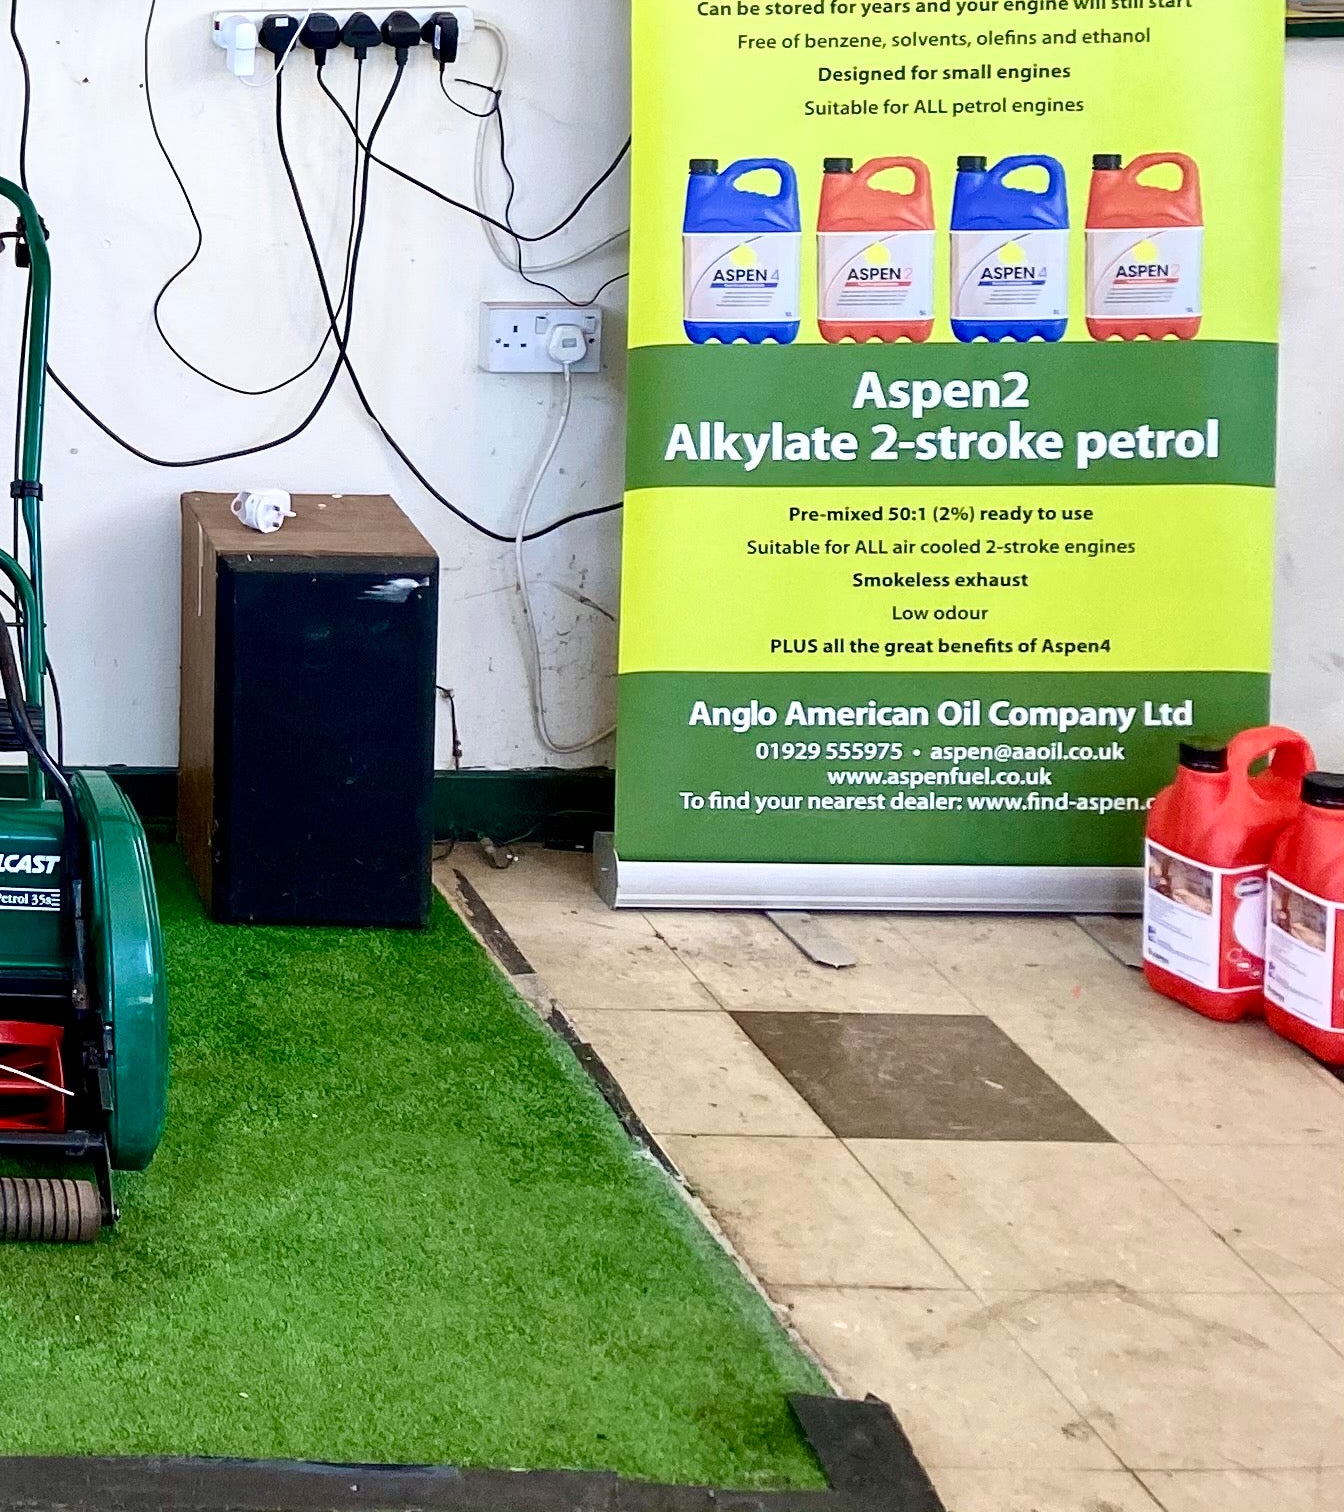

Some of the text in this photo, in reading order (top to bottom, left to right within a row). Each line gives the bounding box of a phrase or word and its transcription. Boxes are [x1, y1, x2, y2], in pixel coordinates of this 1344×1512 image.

[697, 1, 731, 16] Can
[737, 0, 760, 16] be
[765, 0, 825, 16] stored
[861, 2, 911, 18] years
[956, 0, 999, 17] your
[738, 27, 1150, 50] Free of benzene, solvents, olefins and ethanol
[818, 63, 1071, 86] Designed for small engines
[804, 97, 1084, 117] Suitable for ALL petrol engines
[713, 269, 767, 282] ASPEN
[847, 268, 901, 281] ASPEN
[980, 267, 1035, 280] ASPEN
[1116, 264, 1169, 278] ASPEN
[852, 371, 1029, 418] Aspen2
[664, 416, 1219, 472] Alkylate 2-stroke petrol
[789, 505, 1094, 525] Pre-mixed 50:1 (2%) ready to use
[747, 538, 1135, 558] Suitable for ALL air cooled 2-stroke engines
[853, 571, 1028, 588] Smokeless exhaust
[892, 605, 989, 620] Low odour
[771, 638, 1111, 657] PLUS all the great benefits of Aspen4
[688, 699, 1193, 734] Anglo American Oil Company Ltd
[755, 742, 1125, 765] 01929 555975 aspen@aaoil.co.uk
[827, 766, 1052, 789] www.aspenfuel.co.uk
[679, 790, 1156, 815] To find your nearest dealer: www.find-aspen.c
[31, 894, 52, 906] 35s
